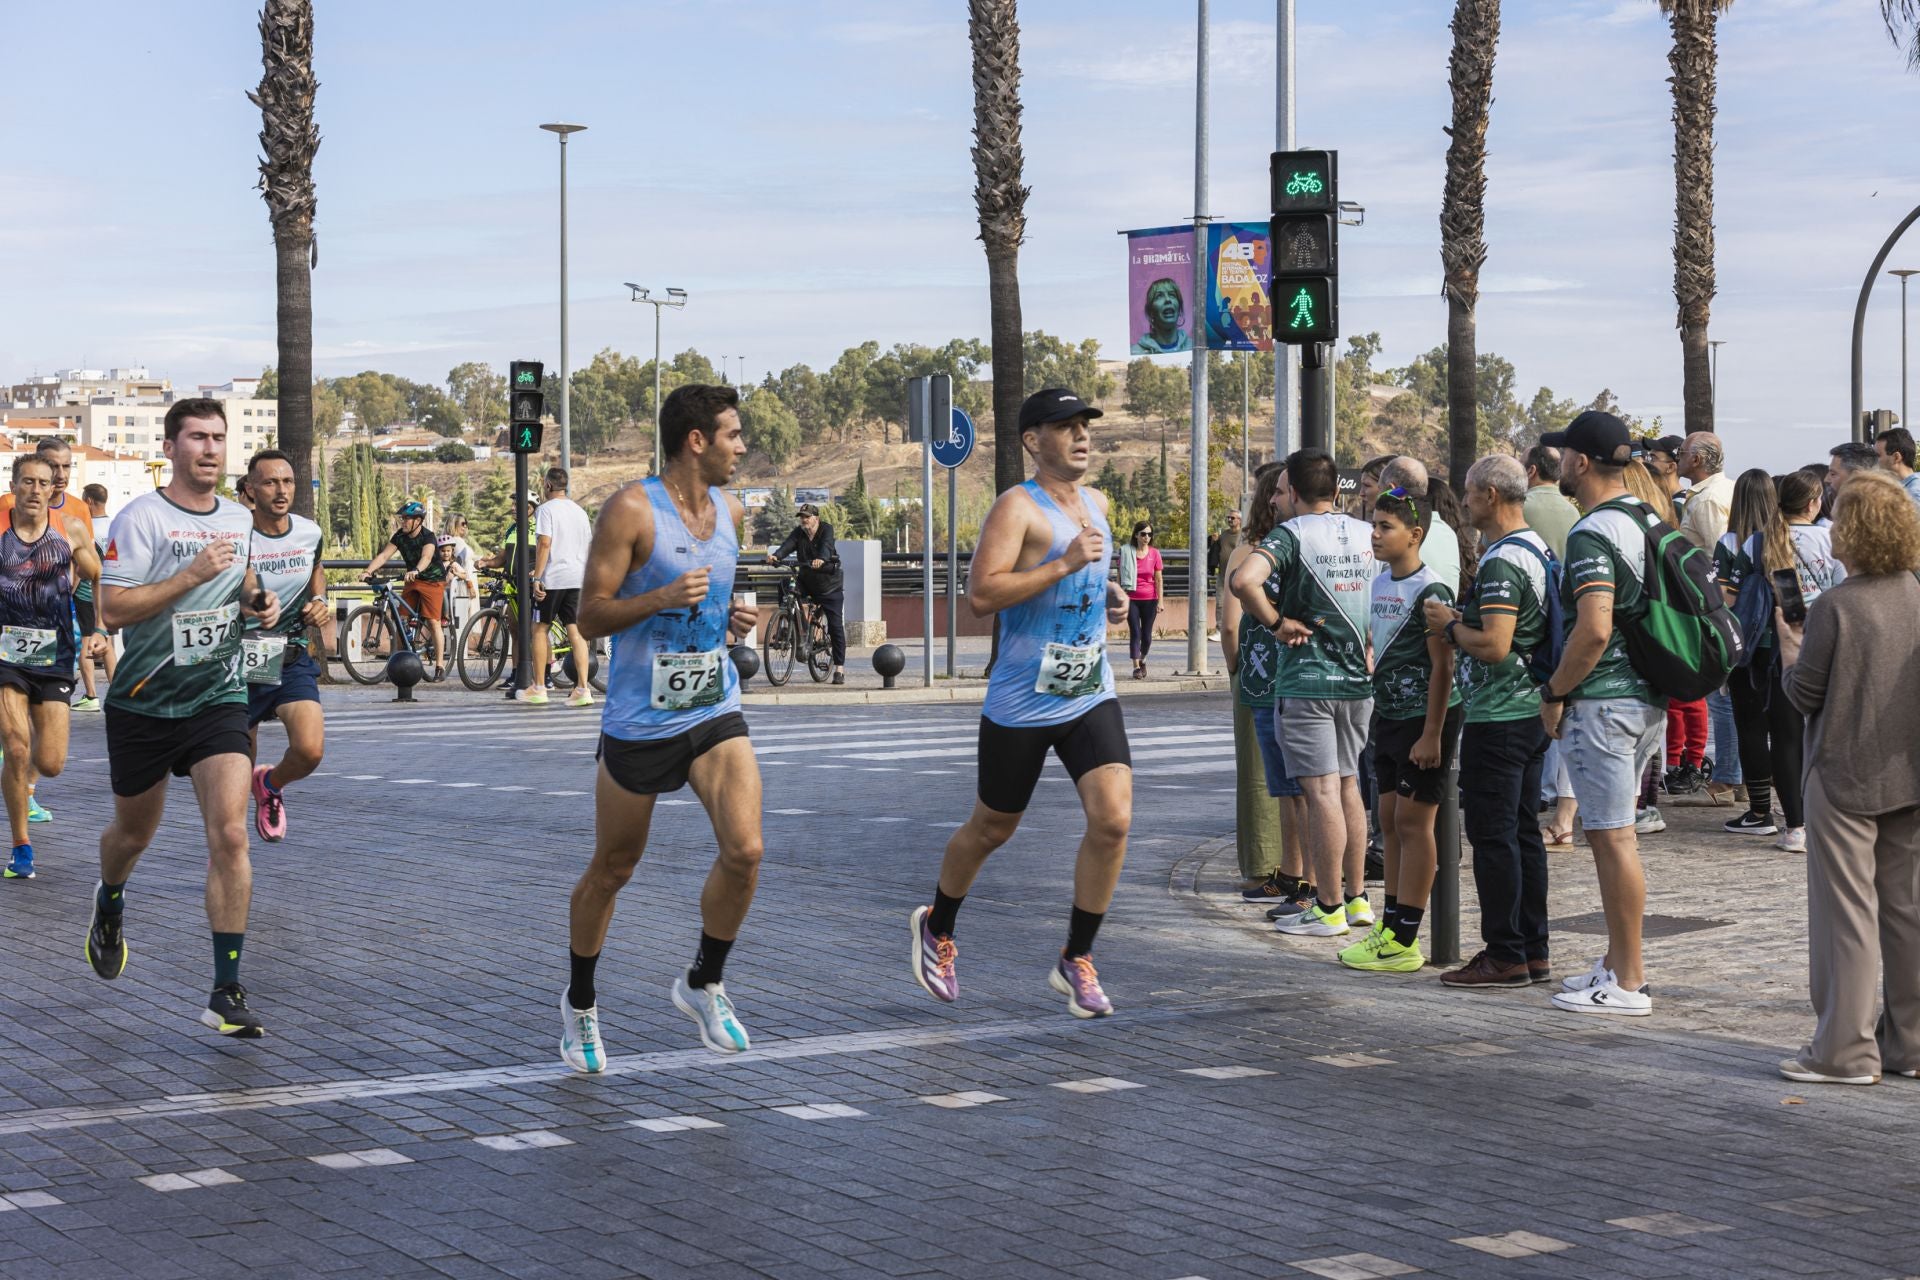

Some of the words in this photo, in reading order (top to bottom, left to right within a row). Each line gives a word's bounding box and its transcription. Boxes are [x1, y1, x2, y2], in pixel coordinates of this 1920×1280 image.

[1221, 242, 1254, 260] 48
[1221, 274, 1268, 284] BADAJOZ
[289, 556, 309, 568] CIVIL
[1315, 554, 1337, 567] CORRE
[1338, 554, 1351, 565] CON
[1353, 554, 1362, 564] EL
[181, 619, 239, 649] 1370
[15, 638, 42, 654] 27
[668, 668, 717, 691] 675
